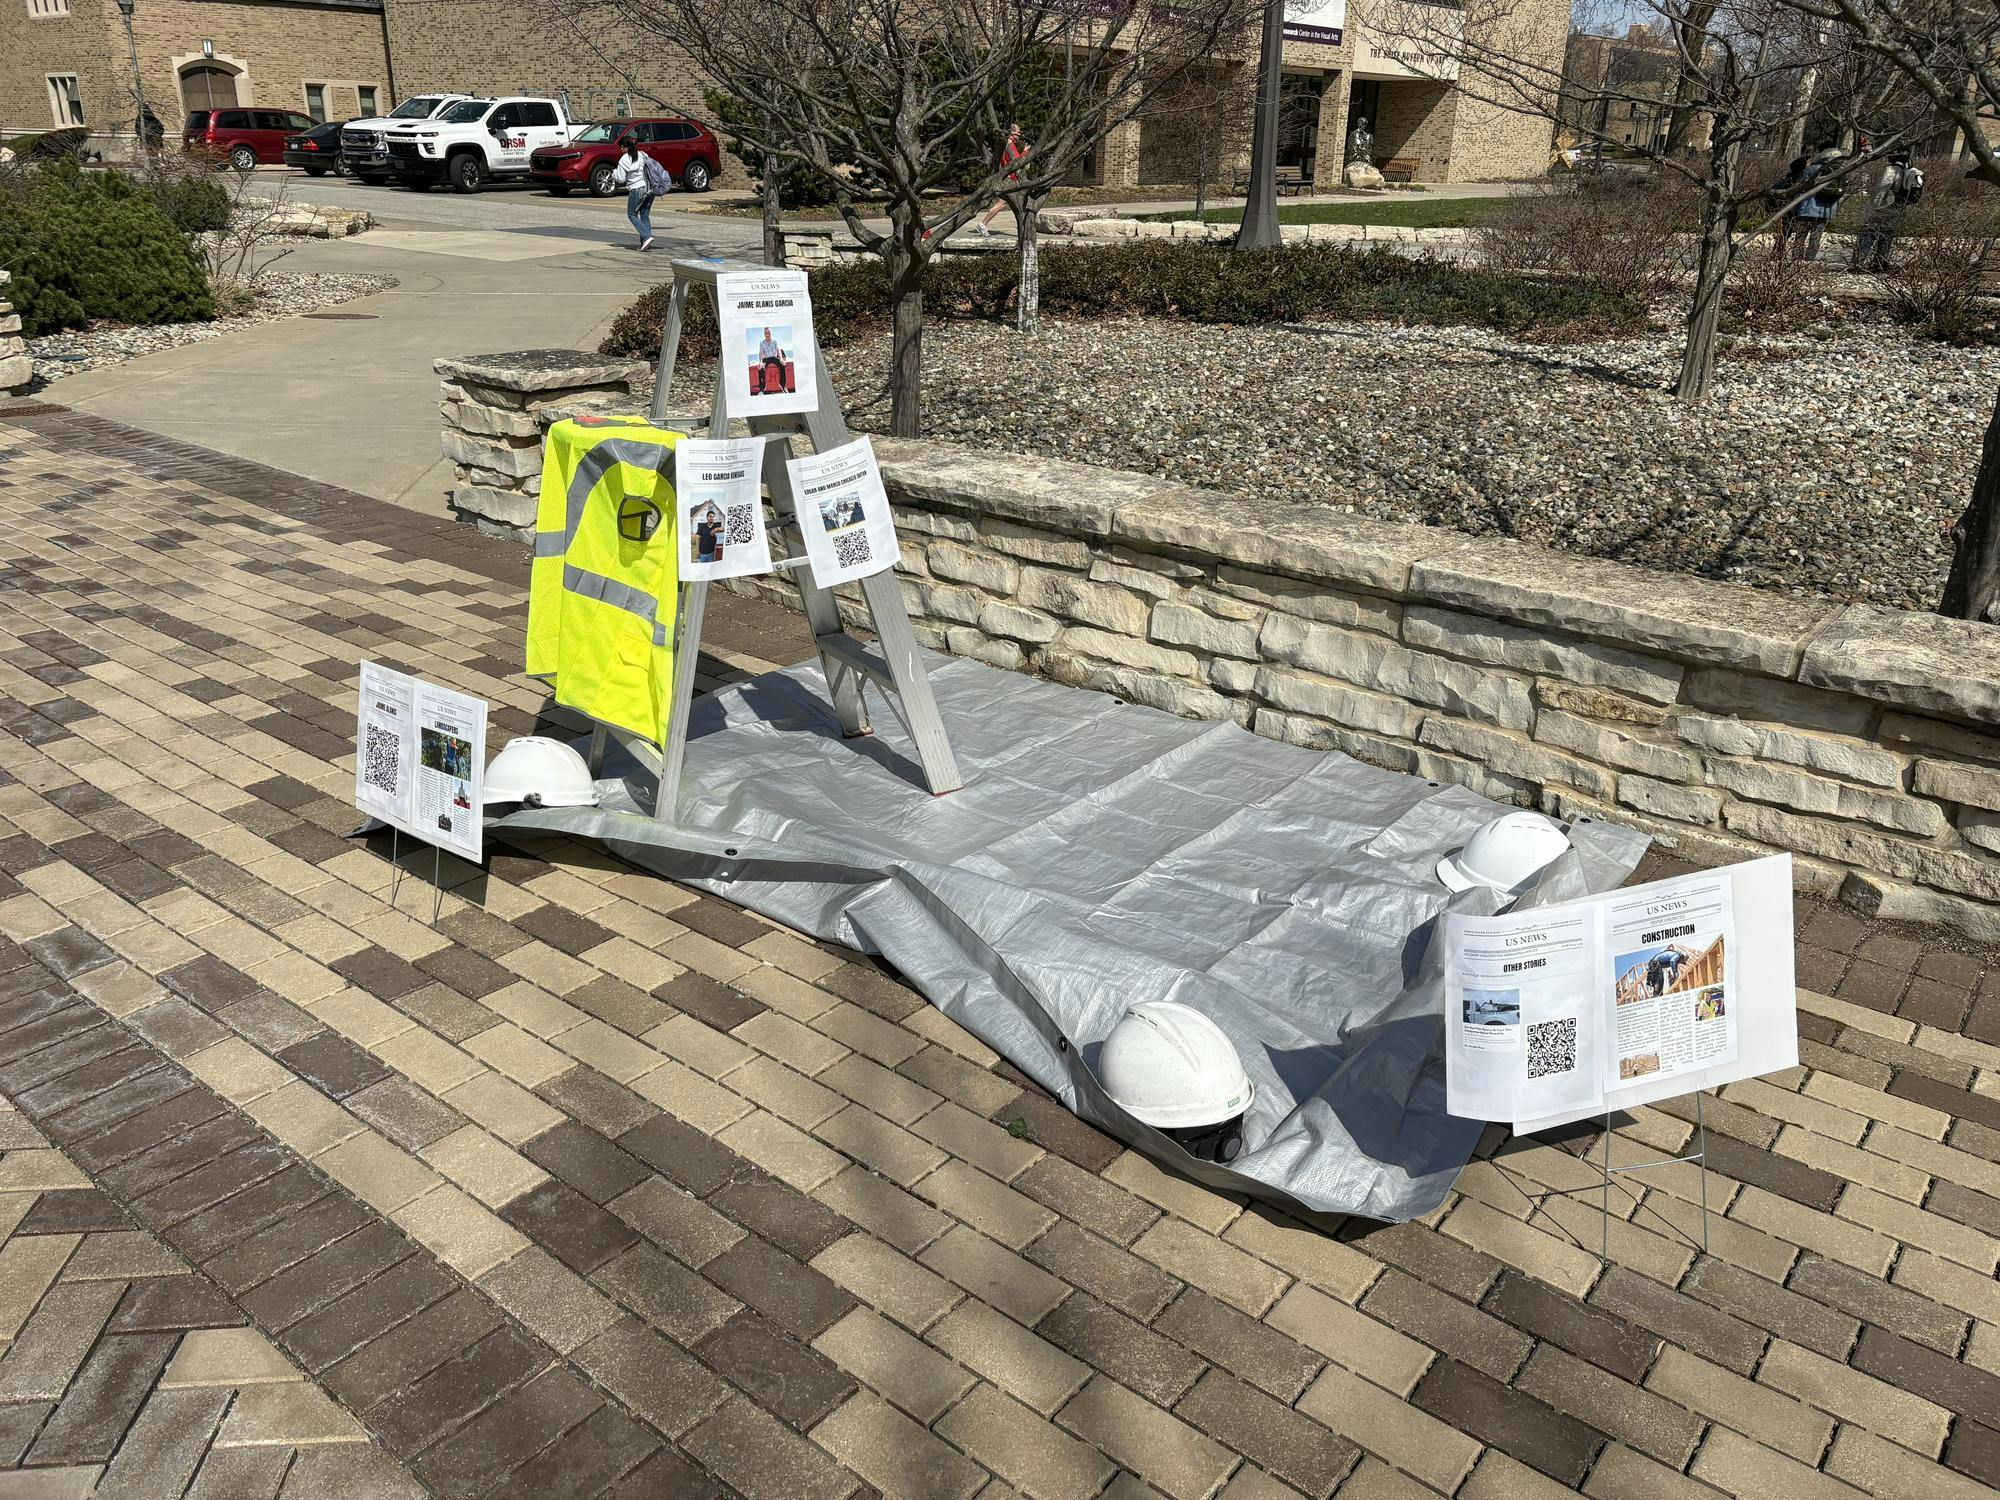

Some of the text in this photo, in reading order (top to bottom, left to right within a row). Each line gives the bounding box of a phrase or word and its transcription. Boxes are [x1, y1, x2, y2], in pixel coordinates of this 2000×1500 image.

[1298, 29, 1310, 38] Center
[1320, 31, 1331, 40] Visual
[1330, 32, 1339, 41] Arts
[1370, 48, 1381, 58] THE
[500, 138, 526, 149] DRSM
[750, 282, 781, 291] US NEWS
[737, 299, 794, 310] JAIME ALANIS GARCIA
[821, 466, 831, 475] US
[831, 461, 849, 472] NEWS
[702, 472, 713, 481] LEO
[713, 472, 730, 481] GARCIA
[803, 487, 818, 496] EDGAR
[817, 484, 827, 493] AND
[444, 707, 457, 716] NEWS
[1646, 904, 1660, 916] US
[1660, 899, 1689, 914] NEWS
[1505, 936, 1518, 947] US
[1519, 932, 1548, 945] NEWS
[1641, 923, 1696, 944] CONSTRUCTION
[1503, 958, 1547, 973] OTHER STORIES
